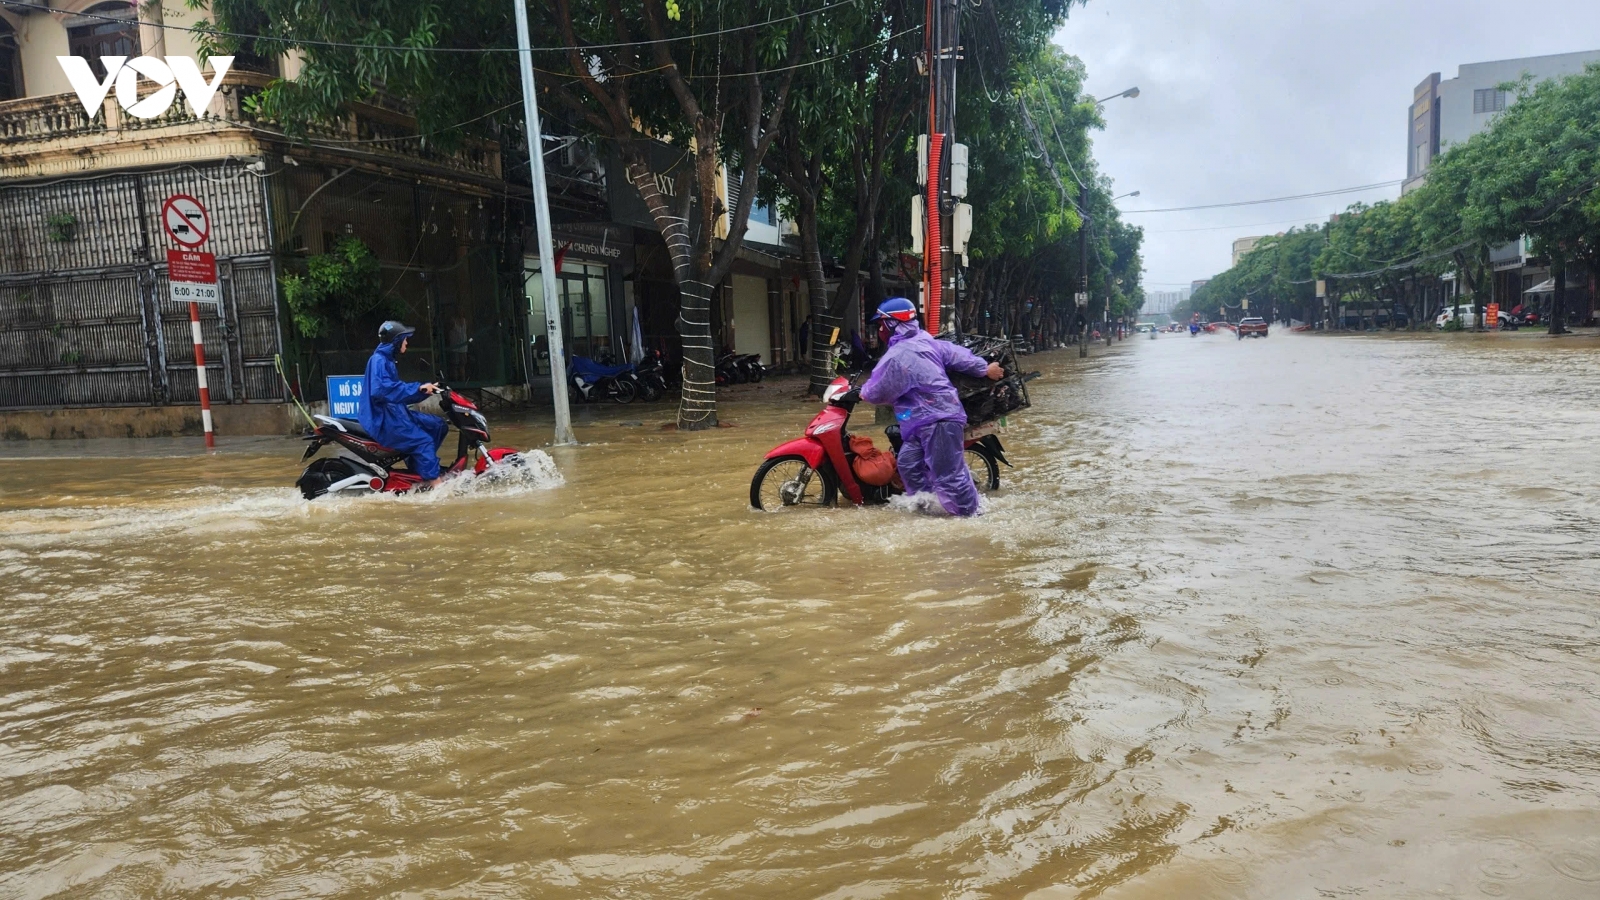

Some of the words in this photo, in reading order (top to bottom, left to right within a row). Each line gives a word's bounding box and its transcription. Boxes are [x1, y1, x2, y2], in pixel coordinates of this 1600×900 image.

[174, 286, 190, 296] 6:00
[195, 288, 215, 298] 21:00
[339, 380, 352, 397] HỐ
[352, 381, 363, 397] SÂ
[333, 402, 355, 415] NGUY
